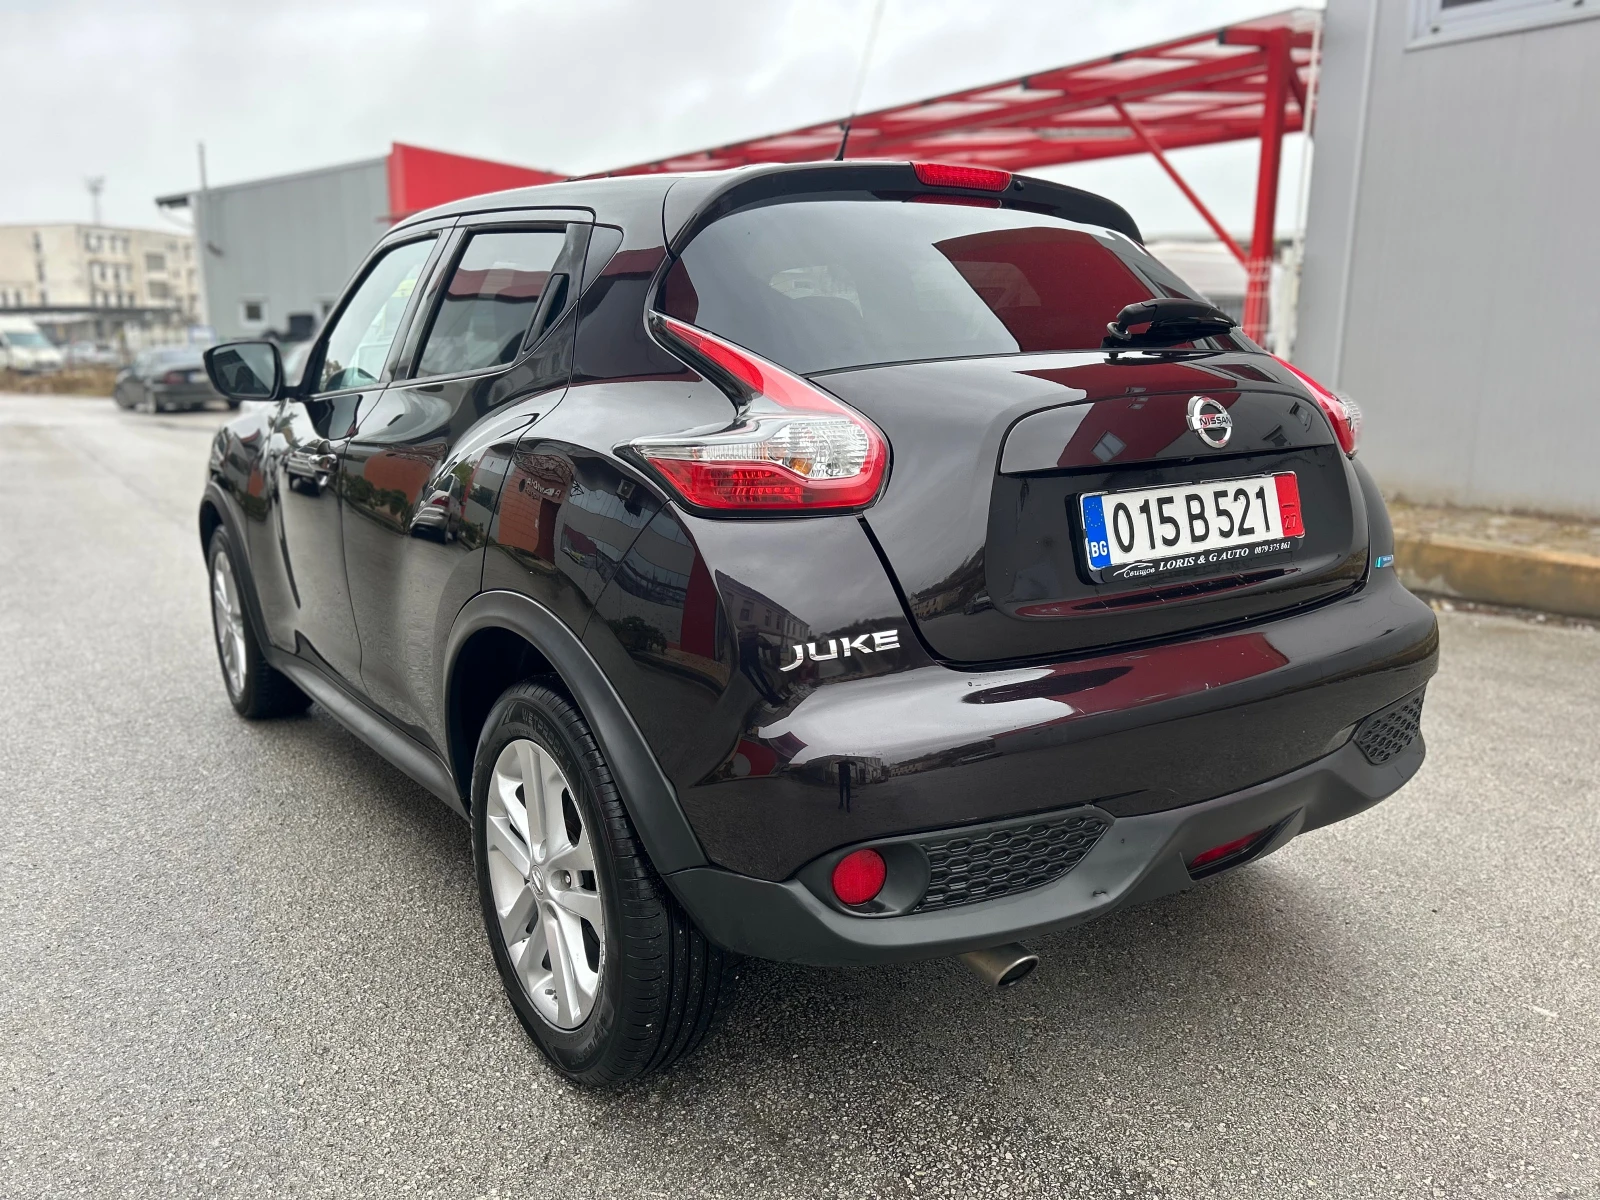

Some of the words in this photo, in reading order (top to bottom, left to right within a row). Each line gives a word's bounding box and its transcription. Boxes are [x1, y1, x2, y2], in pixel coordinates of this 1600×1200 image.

[1199, 416, 1232, 426] NISSAN
[1112, 485, 1271, 553] 015B521
[1092, 541, 1108, 558] BG
[1159, 556, 1196, 571] LORIS
[1197, 555, 1206, 564] &
[1218, 547, 1249, 561] AUTO
[780, 629, 900, 672] JUKE
